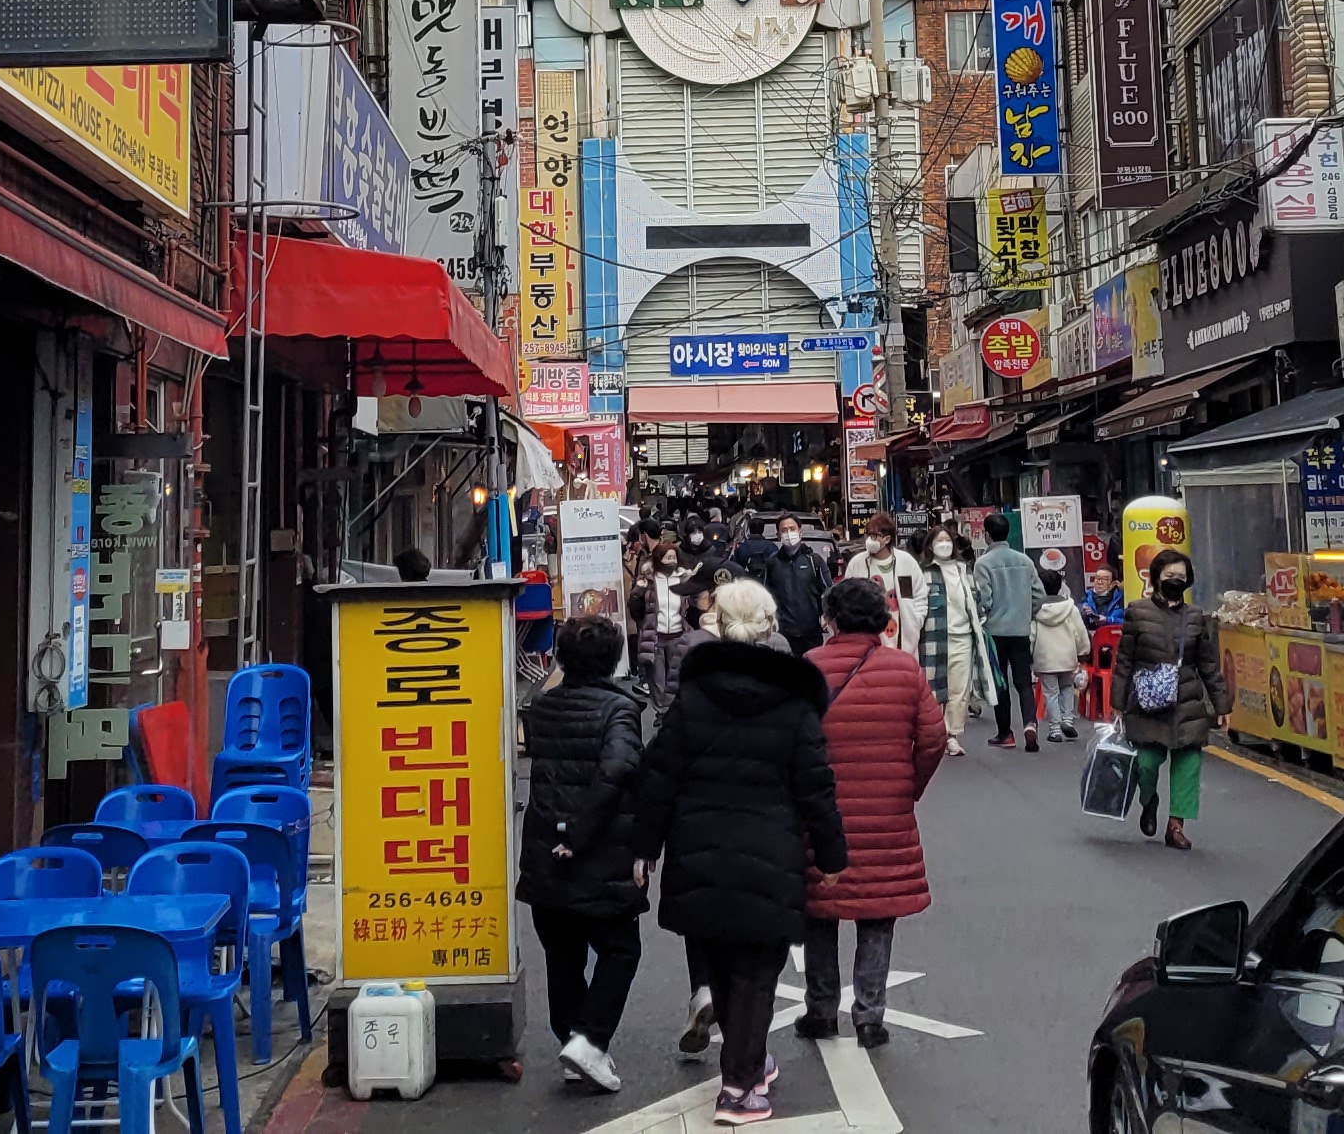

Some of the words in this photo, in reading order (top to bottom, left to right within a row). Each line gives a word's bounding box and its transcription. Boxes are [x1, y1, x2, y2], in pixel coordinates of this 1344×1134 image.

[1117, 19, 1138, 105] FLUE
[1002, 83, 1052, 99] 구워주는
[37, 68, 66, 115] PIZZA
[70, 89, 102, 142] HOUSE
[1113, 111, 1148, 125] 800
[1004, 105, 1050, 168] 남자
[1018, 216, 1040, 259] 막창
[673, 342, 734, 367] 야시장
[738, 342, 778, 357] 찾아오시는
[779, 342, 787, 356] 길
[986, 335, 1036, 357] 족발
[762, 359, 780, 368] 50M
[531, 367, 581, 389] 대방출
[1138, 522, 1153, 530] SBS
[368, 890, 483, 909] 256-4649
